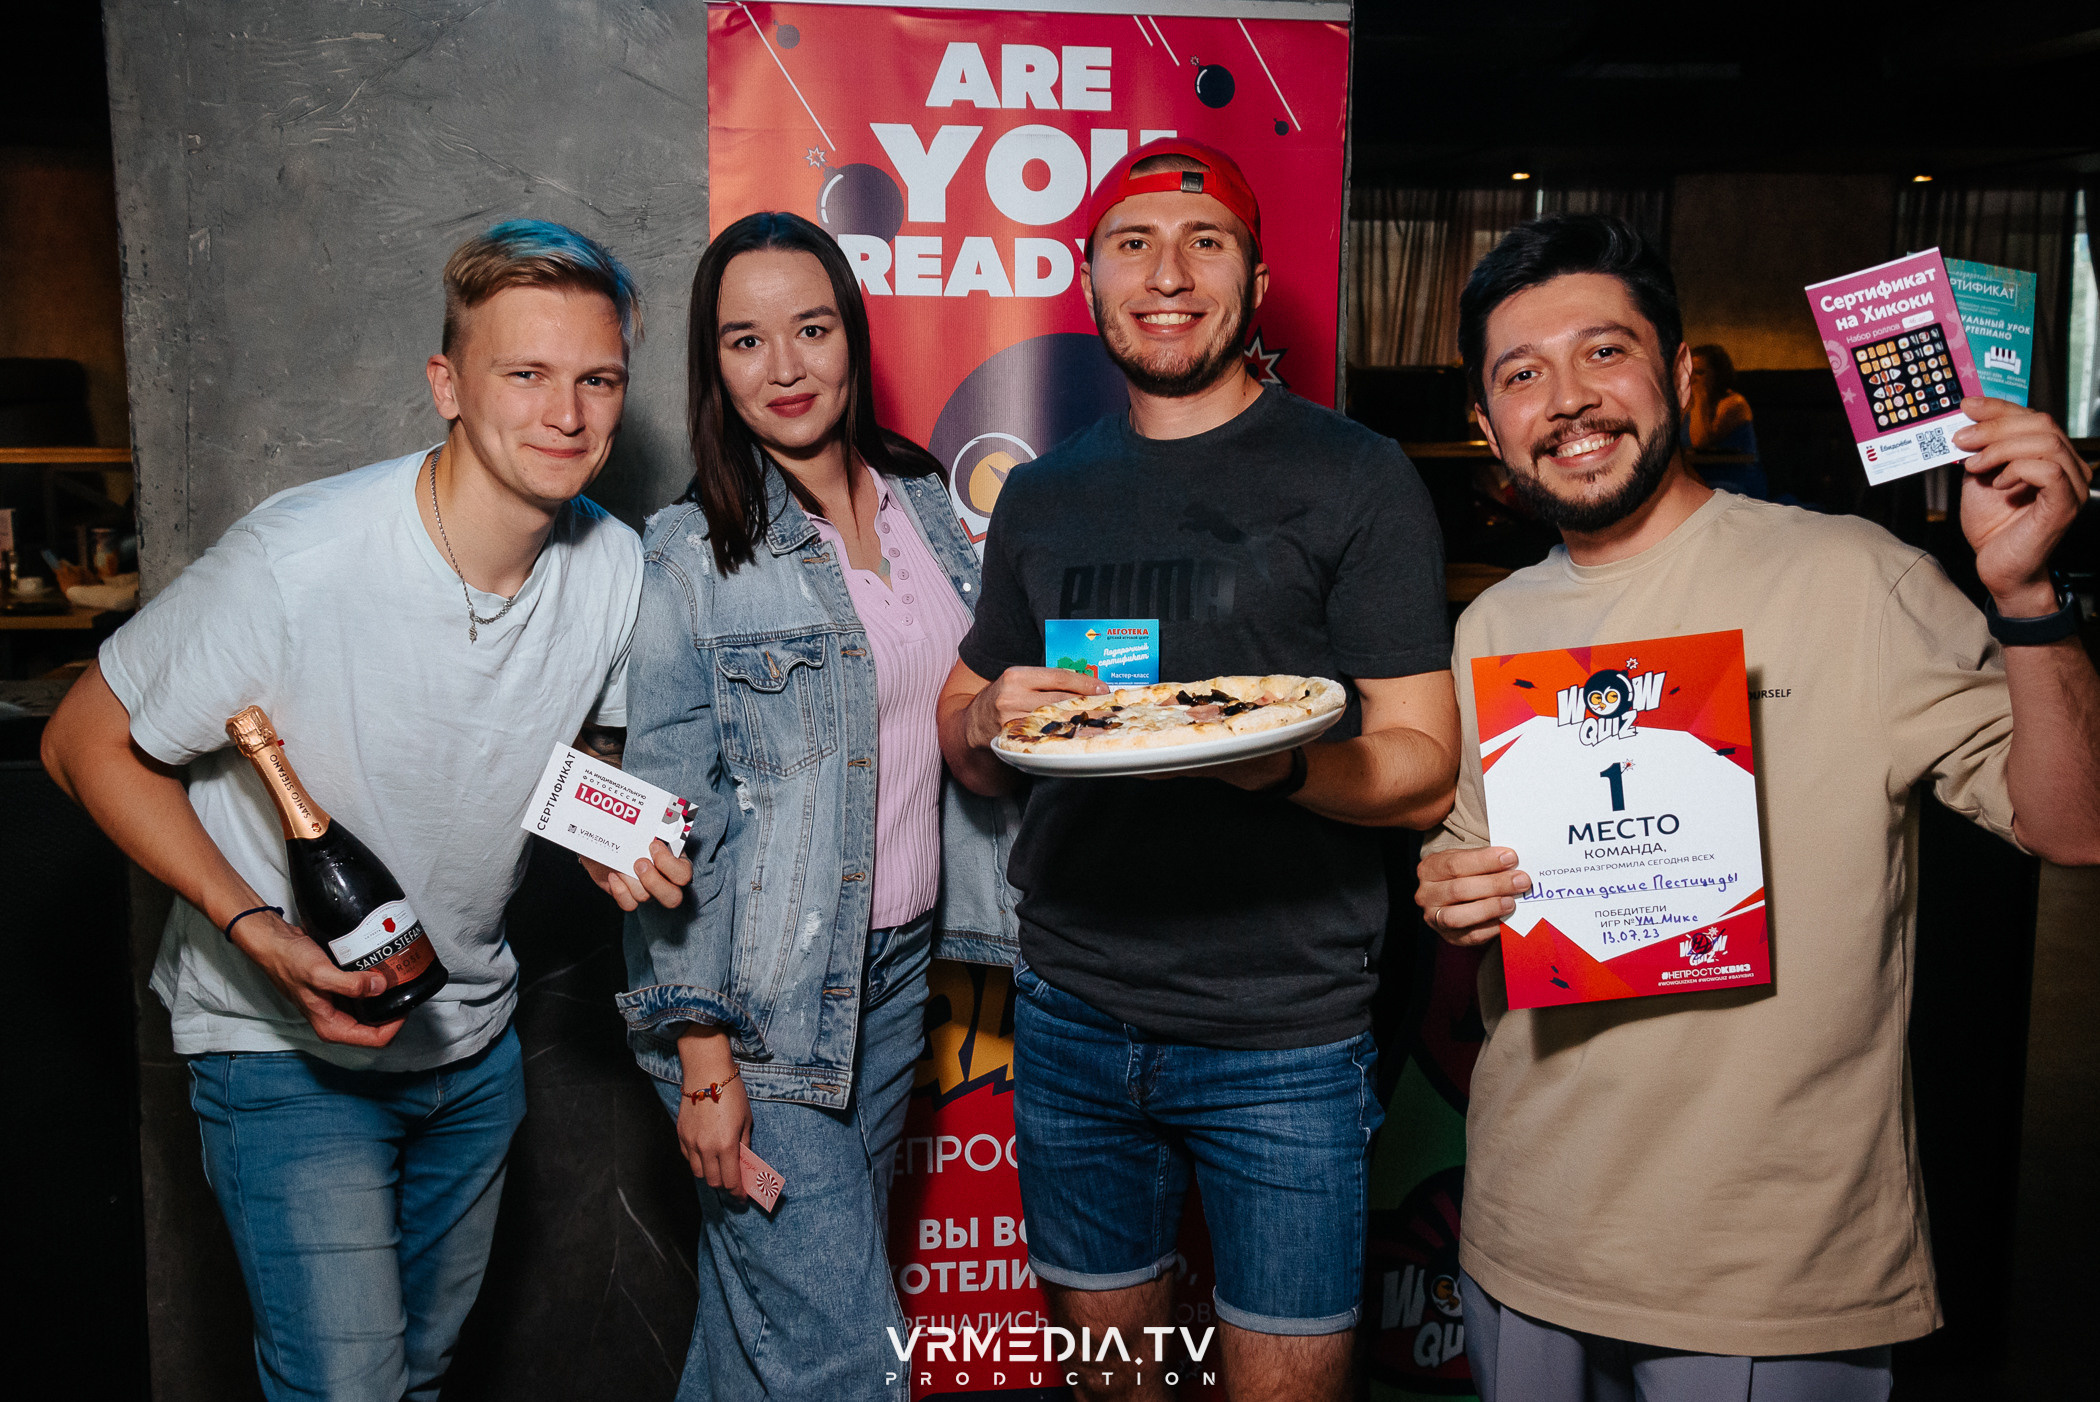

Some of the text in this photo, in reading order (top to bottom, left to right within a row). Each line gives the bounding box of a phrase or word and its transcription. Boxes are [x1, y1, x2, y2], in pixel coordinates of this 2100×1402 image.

[925, 42, 1112, 111] ARE
[838, 234, 1084, 298] READ
[1820, 268, 1936, 312] Сертификат
[1835, 315, 1859, 331] на
[1860, 291, 1934, 324] Хикоки
[1846, 324, 1901, 344] Набор роллов
[2007, 322, 2031, 335] УРОК
[1107, 628, 1149, 636] ЛЕГОТЕКА
[1103, 642, 1149, 658] Подарочный
[1110, 672, 1149, 680] Мастер-класс
[1579, 709, 1638, 747] QUIZ
[269, 754, 311, 819] SANTO STEFANO
[537, 751, 576, 831] СЕРТИФИКАТ
[582, 775, 645, 806] ФОТОСЕССИЮ
[593, 773, 647, 800] ИНДИВИДУАЛЬНУЮ
[1600, 762, 1625, 812] 1
[580, 828, 620, 850] VRMEDIA.TV
[1568, 813, 1680, 845] МЕСТО
[1584, 842, 1667, 860] КОМАНДА,
[1539, 853, 1715, 877] КОТОРАЯ РАЗГРОМИЛА СЕГОДНЯ ВСЕХ
[1594, 905, 1667, 918] ПОБЕДИТЕЛИ
[1600, 919, 1621, 928] ИГР
[1602, 928, 1660, 944] 13.07.23
[355, 946, 393, 971] SANTO
[1661, 963, 1751, 980] #НЕПРОСТОКВИЗ
[918, 1217, 979, 1250] ВЫ
[890, 1258, 1038, 1295] ОТЕЛИ
[1413, 1321, 1465, 1369] QU
